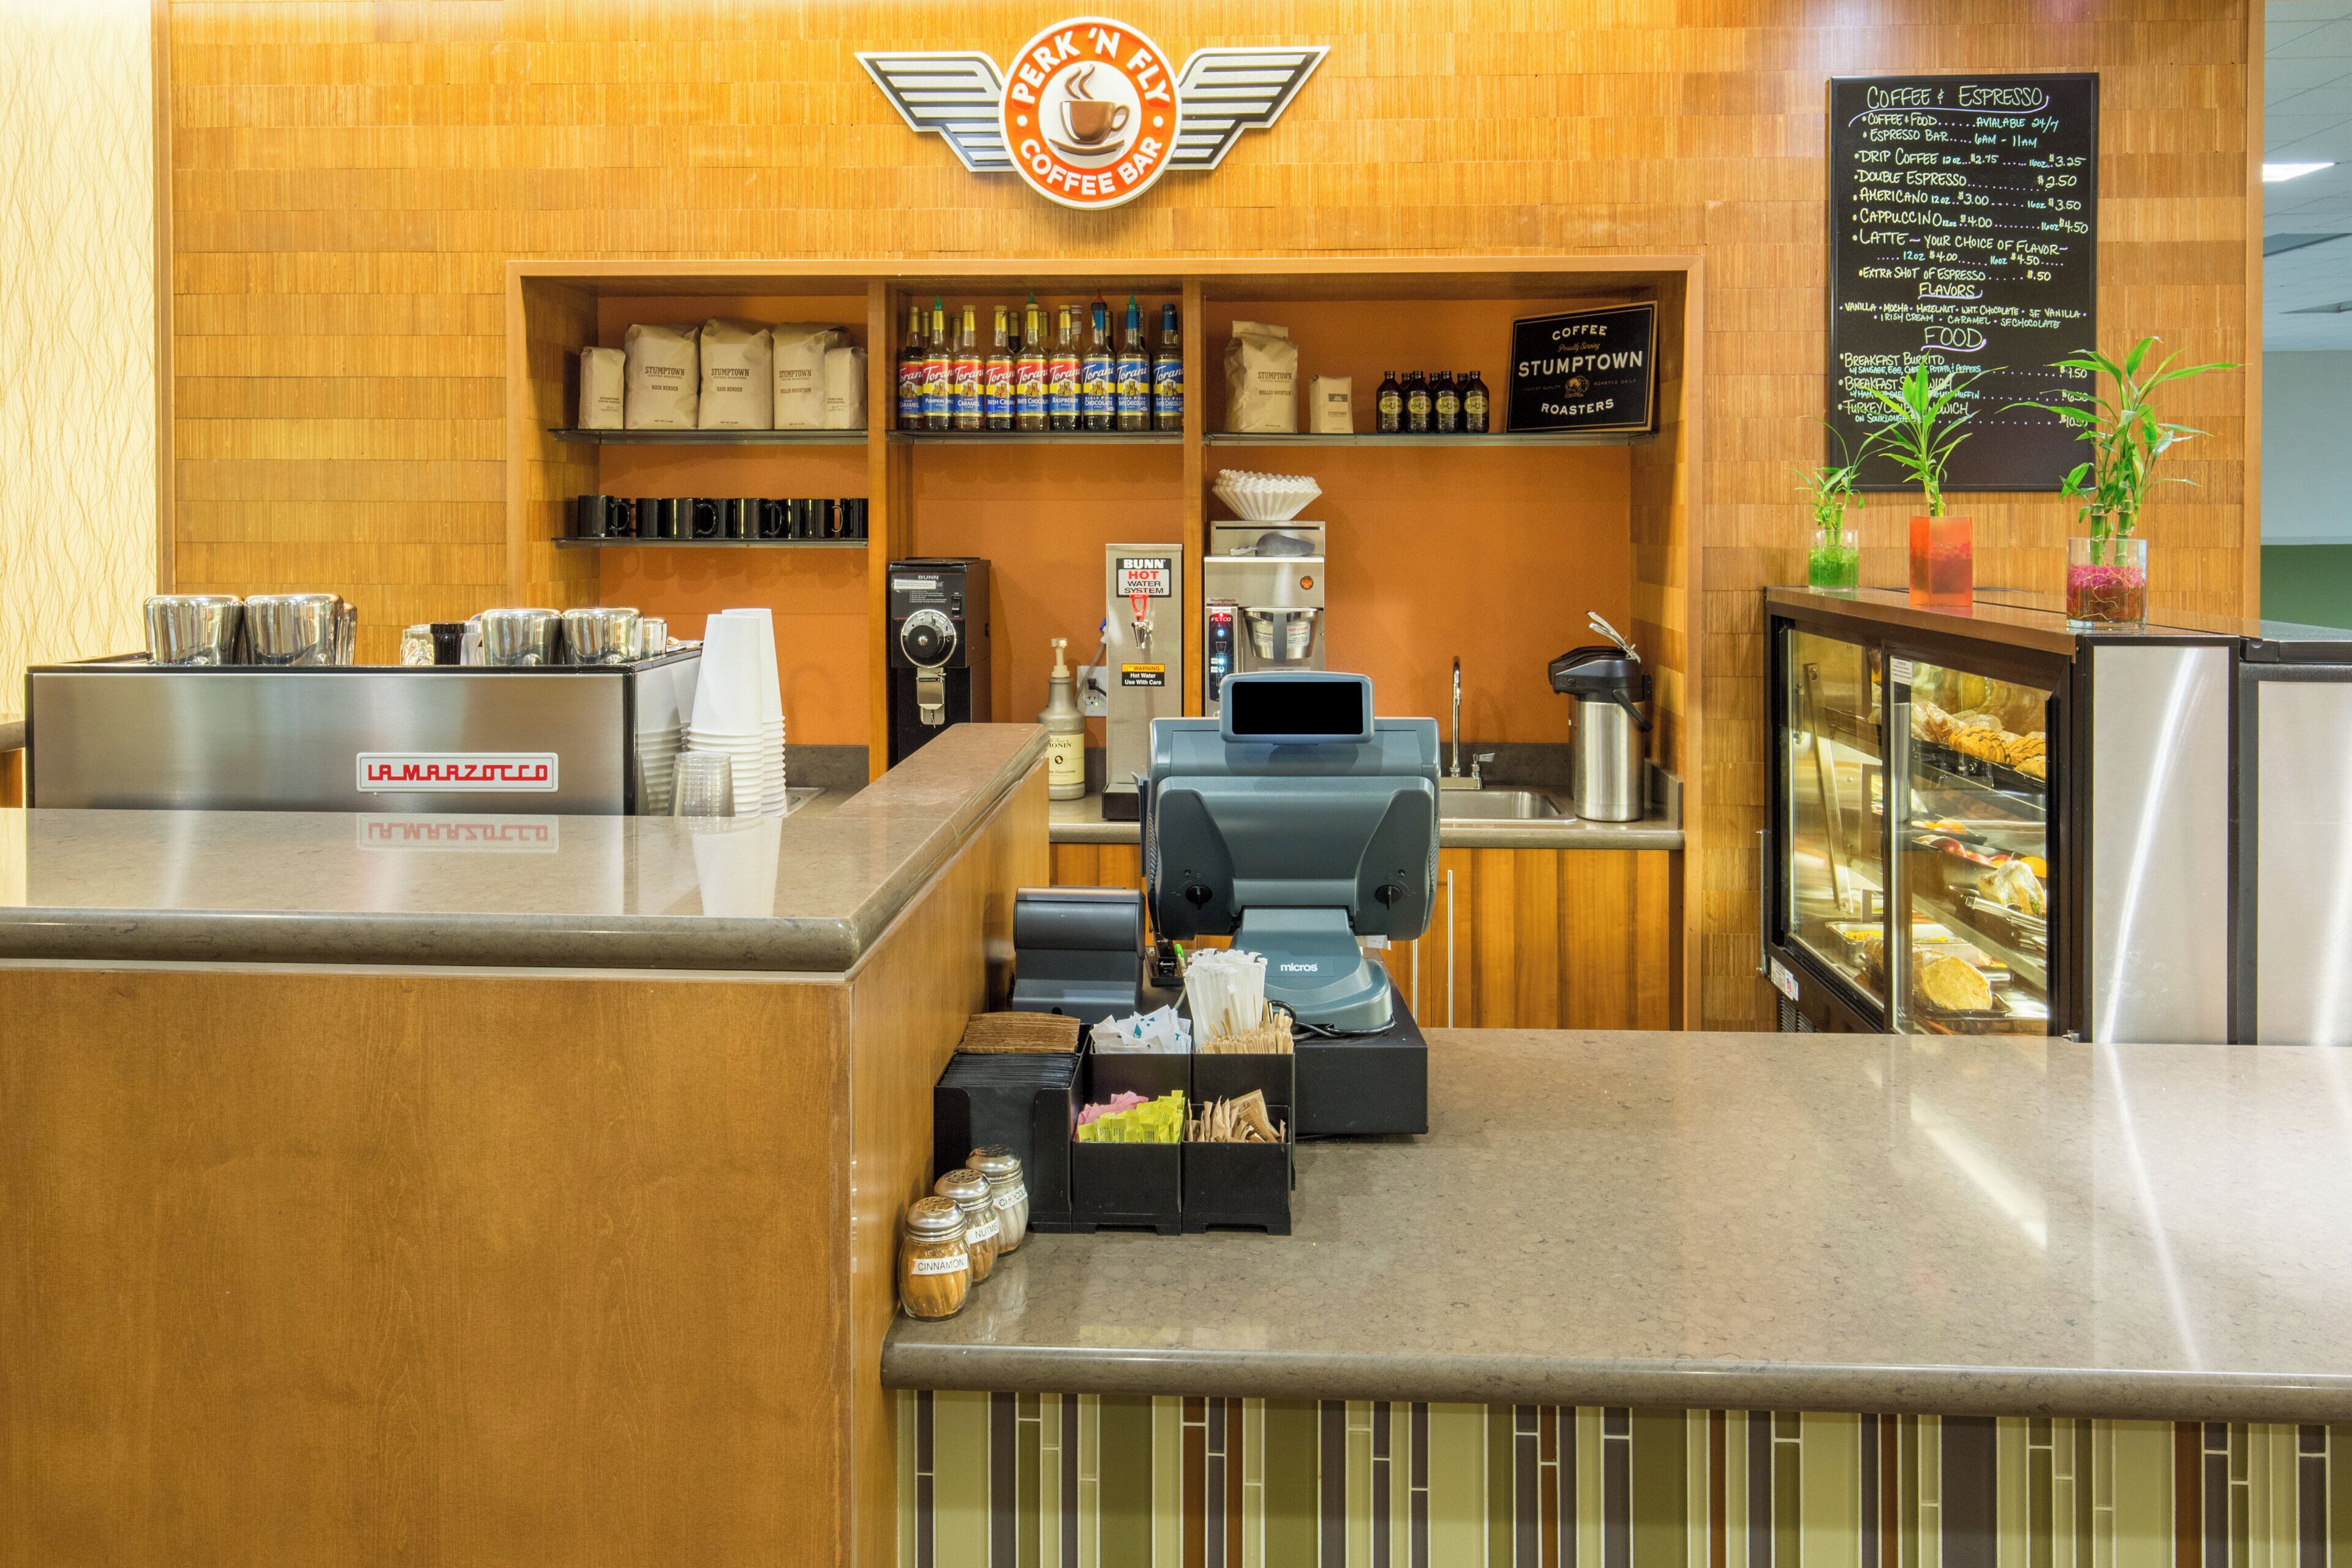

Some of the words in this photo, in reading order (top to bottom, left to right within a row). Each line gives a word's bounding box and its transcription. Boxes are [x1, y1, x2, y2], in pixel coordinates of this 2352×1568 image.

[1011, 30, 1081, 105] PERK
[1088, 27, 1120, 59] 'N
[1126, 47, 1170, 103] FLY
[1867, 86, 1932, 109] COFFEE
[1958, 85, 2043, 107] ESPRESSO
[1868, 112, 1904, 126] COFFEE
[1910, 112, 1937, 126] FOOD
[1976, 116, 2026, 129] AVIALABLE
[2031, 116, 2059, 133] 24/7
[1869, 128, 1921, 142] ESPRESSO
[1924, 129, 1949, 142] BAR
[1974, 132, 1997, 145] 6AM
[2012, 134, 2038, 148] 11AM
[1858, 149, 1891, 163] DRIP
[1895, 147, 1939, 165] COFFEE
[1020, 138, 1116, 195] COFFEE
[1117, 137, 1163, 185] BAR
[1856, 169, 1904, 184] DOUBLE
[1906, 170, 1967, 187] ESPRESSO
[2037, 175, 2077, 189] $2.50
[1859, 186, 1928, 204] AMERICANO
[1957, 190, 1989, 206] $3.00
[2048, 197, 2081, 211] $3.50
[1860, 208, 1942, 227] CAPPUCCINO
[1959, 214, 1992, 228] $4.00
[2059, 217, 2089, 235] $4.50
[1860, 228, 1909, 246] LATTE
[1924, 234, 1951, 249] YOUR
[1954, 235, 1994, 249] CHOICE
[1997, 239, 2015, 251] OF
[2016, 239, 2060, 255] FLAVOR
[1929, 250, 1958, 263] $4.00
[2010, 252, 2040, 266] $4.50
[1863, 266, 1893, 279] EXTRA
[1893, 266, 1921, 279] SHOT
[1923, 266, 1937, 280] OF
[1937, 267, 1986, 281] ESPRESSO
[1919, 282, 1975, 297] FLAVORS
[1844, 301, 1877, 312] VANILLA
[1883, 303, 1909, 314] MOCHA
[1916, 303, 1956, 314] HAZELNUT
[1979, 304, 2019, 316] CHOCOLATE
[2044, 307, 2081, 319] VANILLA
[1880, 312, 1904, 323] IRISH
[1905, 313, 1934, 323] CREAM
[1947, 315, 1991, 325] CARAMEL
[1551, 325, 1608, 341] COFFEE
[1924, 325, 1983, 348] FOOD
[1558, 342, 1580, 353] Proudly
[1580, 341, 1601, 351] Serving
[1518, 350, 1643, 377] STUMPTOWN
[1844, 352, 1901, 368] BREAKFAST
[1902, 352, 1945, 366] BURRITO
[644, 366, 686, 376] STUMPTOWN
[778, 369, 812, 379] STUMPTOWN
[955, 365, 984, 385] Torani
[1017, 365, 1048, 386] Torani
[1050, 364, 1080, 386] Torani
[1084, 364, 1114, 384] Torani
[1117, 364, 1147, 384] Torani
[1257, 371, 1292, 380] STUMPTOWN
[1844, 375, 1899, 391] BREAKFAST
[1540, 399, 1615, 415] ROASTERS
[1843, 399, 1885, 416] TURKEY
[1855, 414, 1864, 423] ON
[1123, 559, 1164, 569] BUNN
[1128, 570, 1159, 580] HOT
[1280, 963, 1318, 971] micros
[918, 1257, 965, 1272] CINNAMON
